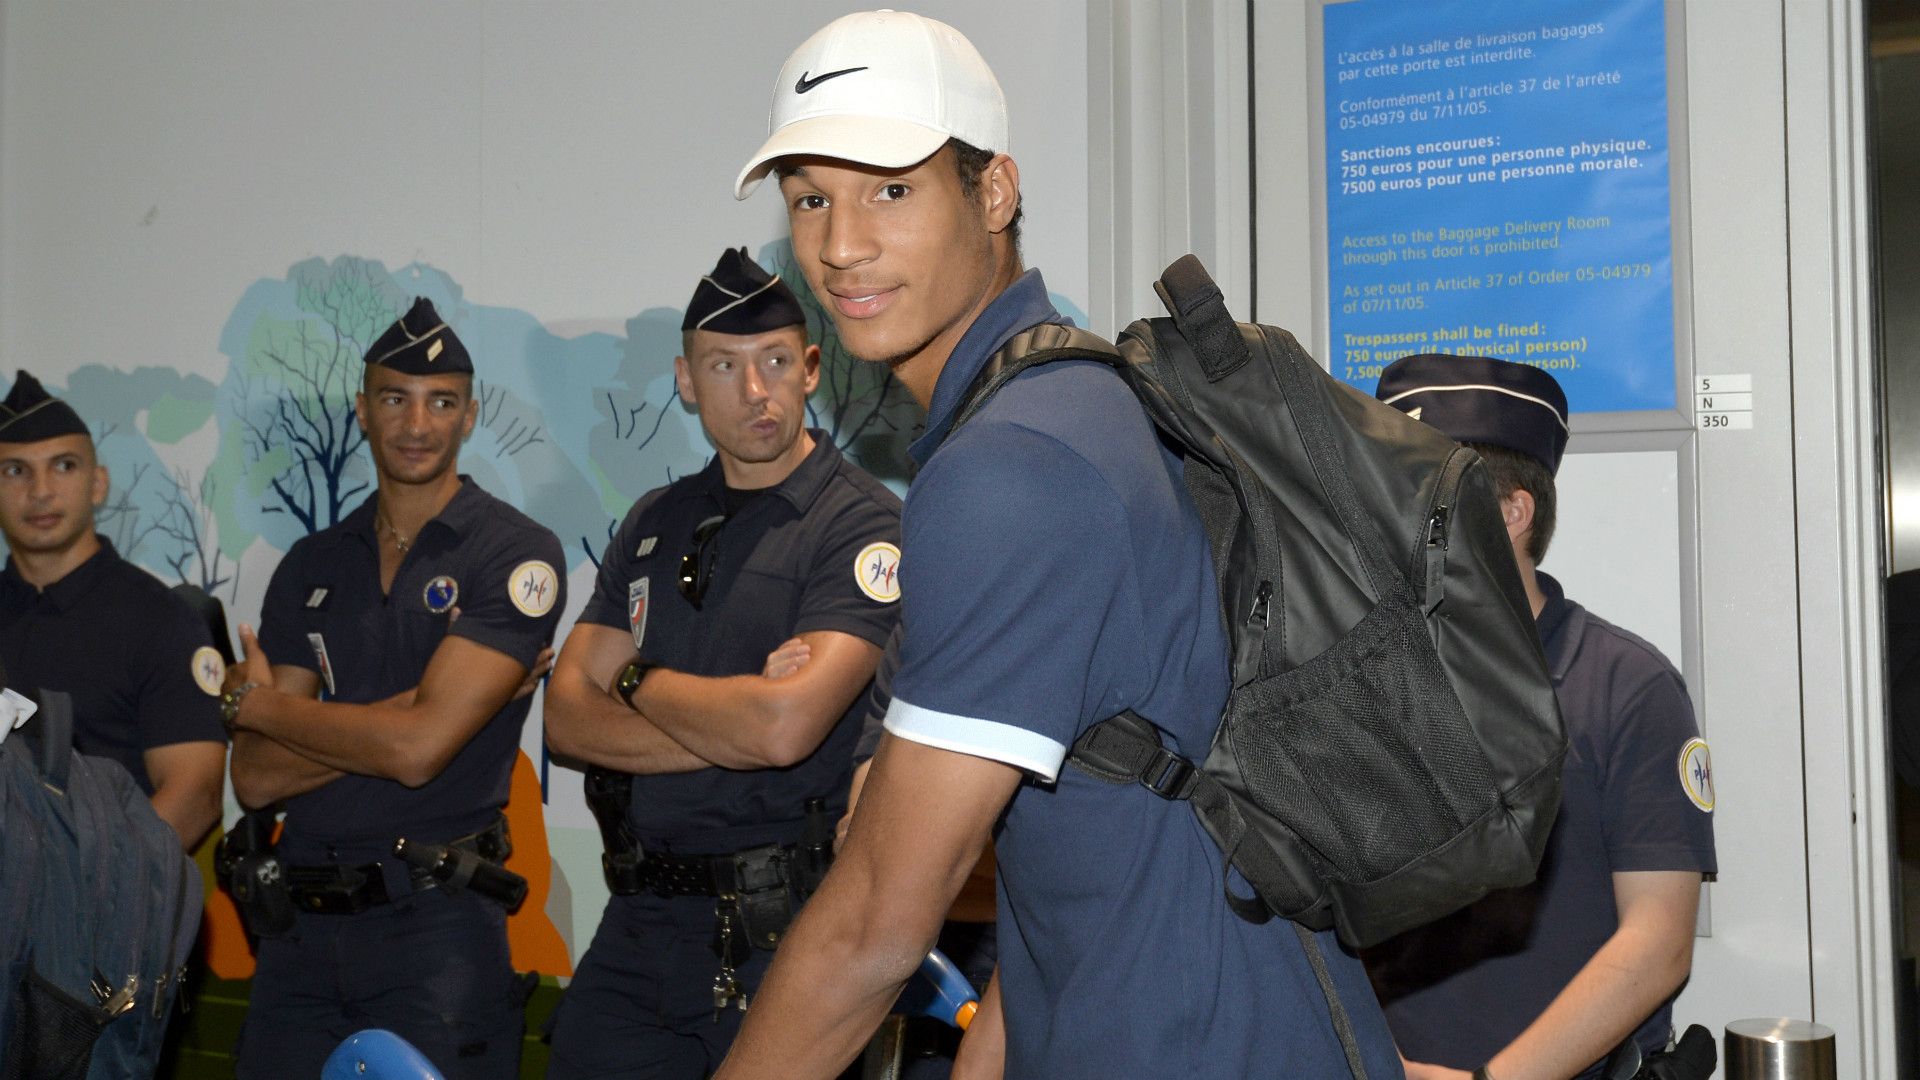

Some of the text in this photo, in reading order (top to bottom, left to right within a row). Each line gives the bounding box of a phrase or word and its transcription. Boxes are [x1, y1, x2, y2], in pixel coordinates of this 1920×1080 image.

[1338, 22, 1605, 65] L'accès à la salle de livraison bagages
[1338, 46, 1536, 83] par cette porte est interdite.
[1339, 69, 1622, 114] Conformément à l'article 37 de l'arrêté
[1340, 100, 1492, 130] 05-04979 du 7/11/05.
[1341, 135, 1501, 162] Sanctions encourues:
[1342, 138, 1652, 179] 750 euros pour une personne physique.
[1342, 155, 1644, 195] 7500 euros pour une personne morale.
[1343, 215, 1610, 248] Access to the Baggage Delivery Room
[1343, 234, 1562, 266] through this door is prohibited.
[1343, 263, 1652, 298] As set out in Article 37 of Order 05-04979
[1343, 295, 1429, 314] of 07/11/05.
[1344, 321, 1547, 347] Trespassers shall be fined:
[1345, 348, 1370, 363] 750
[1374, 348, 1415, 361] euros
[1456, 339, 1520, 357] physical
[1525, 335, 1587, 356] person)
[1345, 365, 1383, 380] 7,500
[1702, 378, 1711, 391] 5
[1703, 397, 1713, 409] N
[1703, 415, 1729, 428] 350
